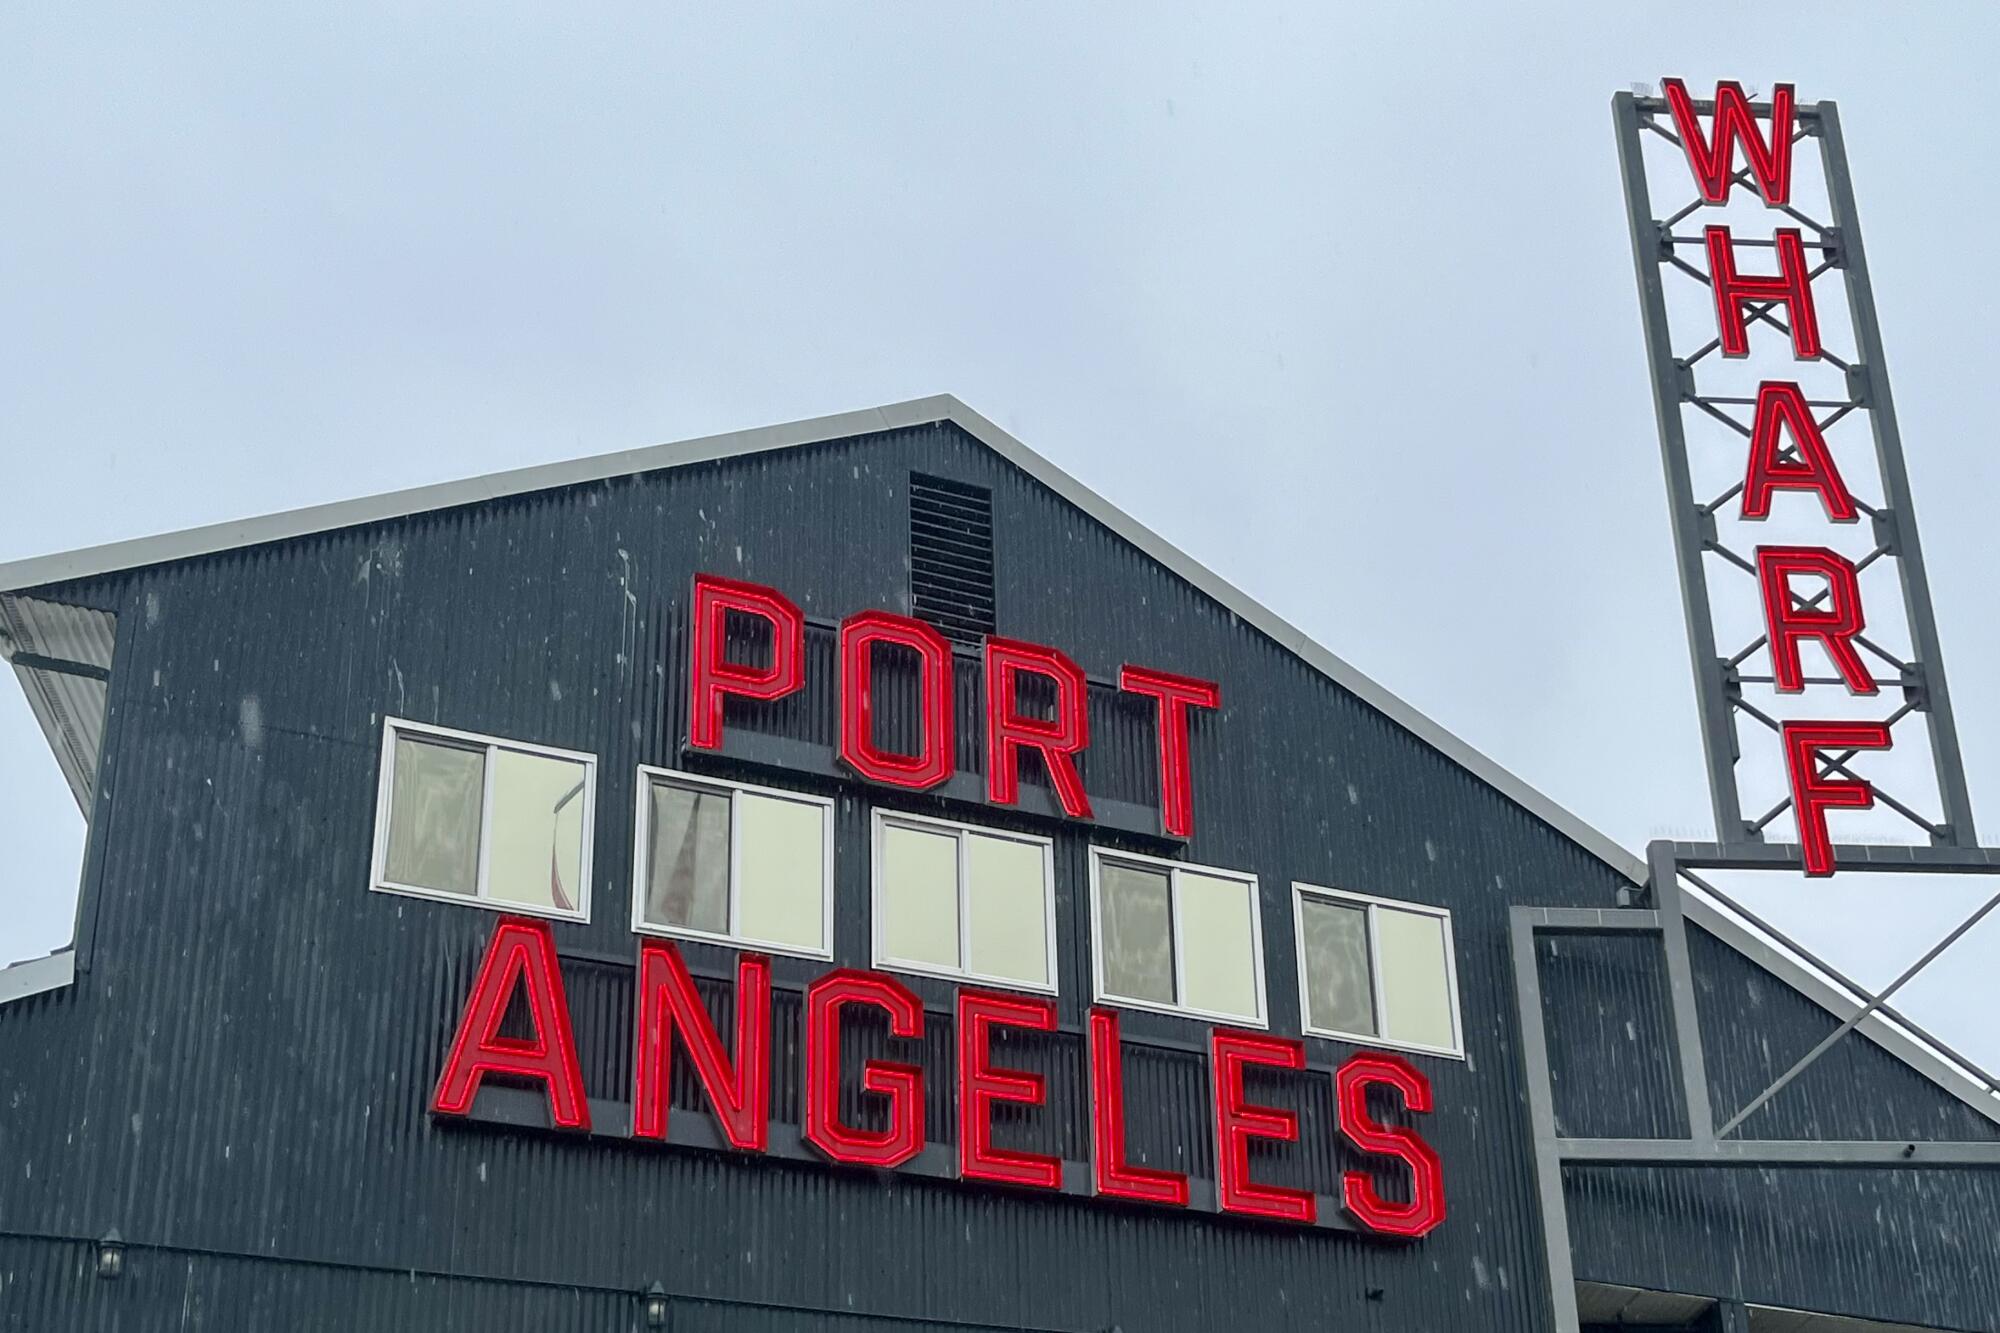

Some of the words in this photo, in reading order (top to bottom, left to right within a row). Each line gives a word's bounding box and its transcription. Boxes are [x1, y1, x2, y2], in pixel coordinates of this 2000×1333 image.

[1660, 77, 1893, 878] WHARF
[688, 573, 1221, 840] PORT
[430, 914, 1447, 1239] ANGELES
